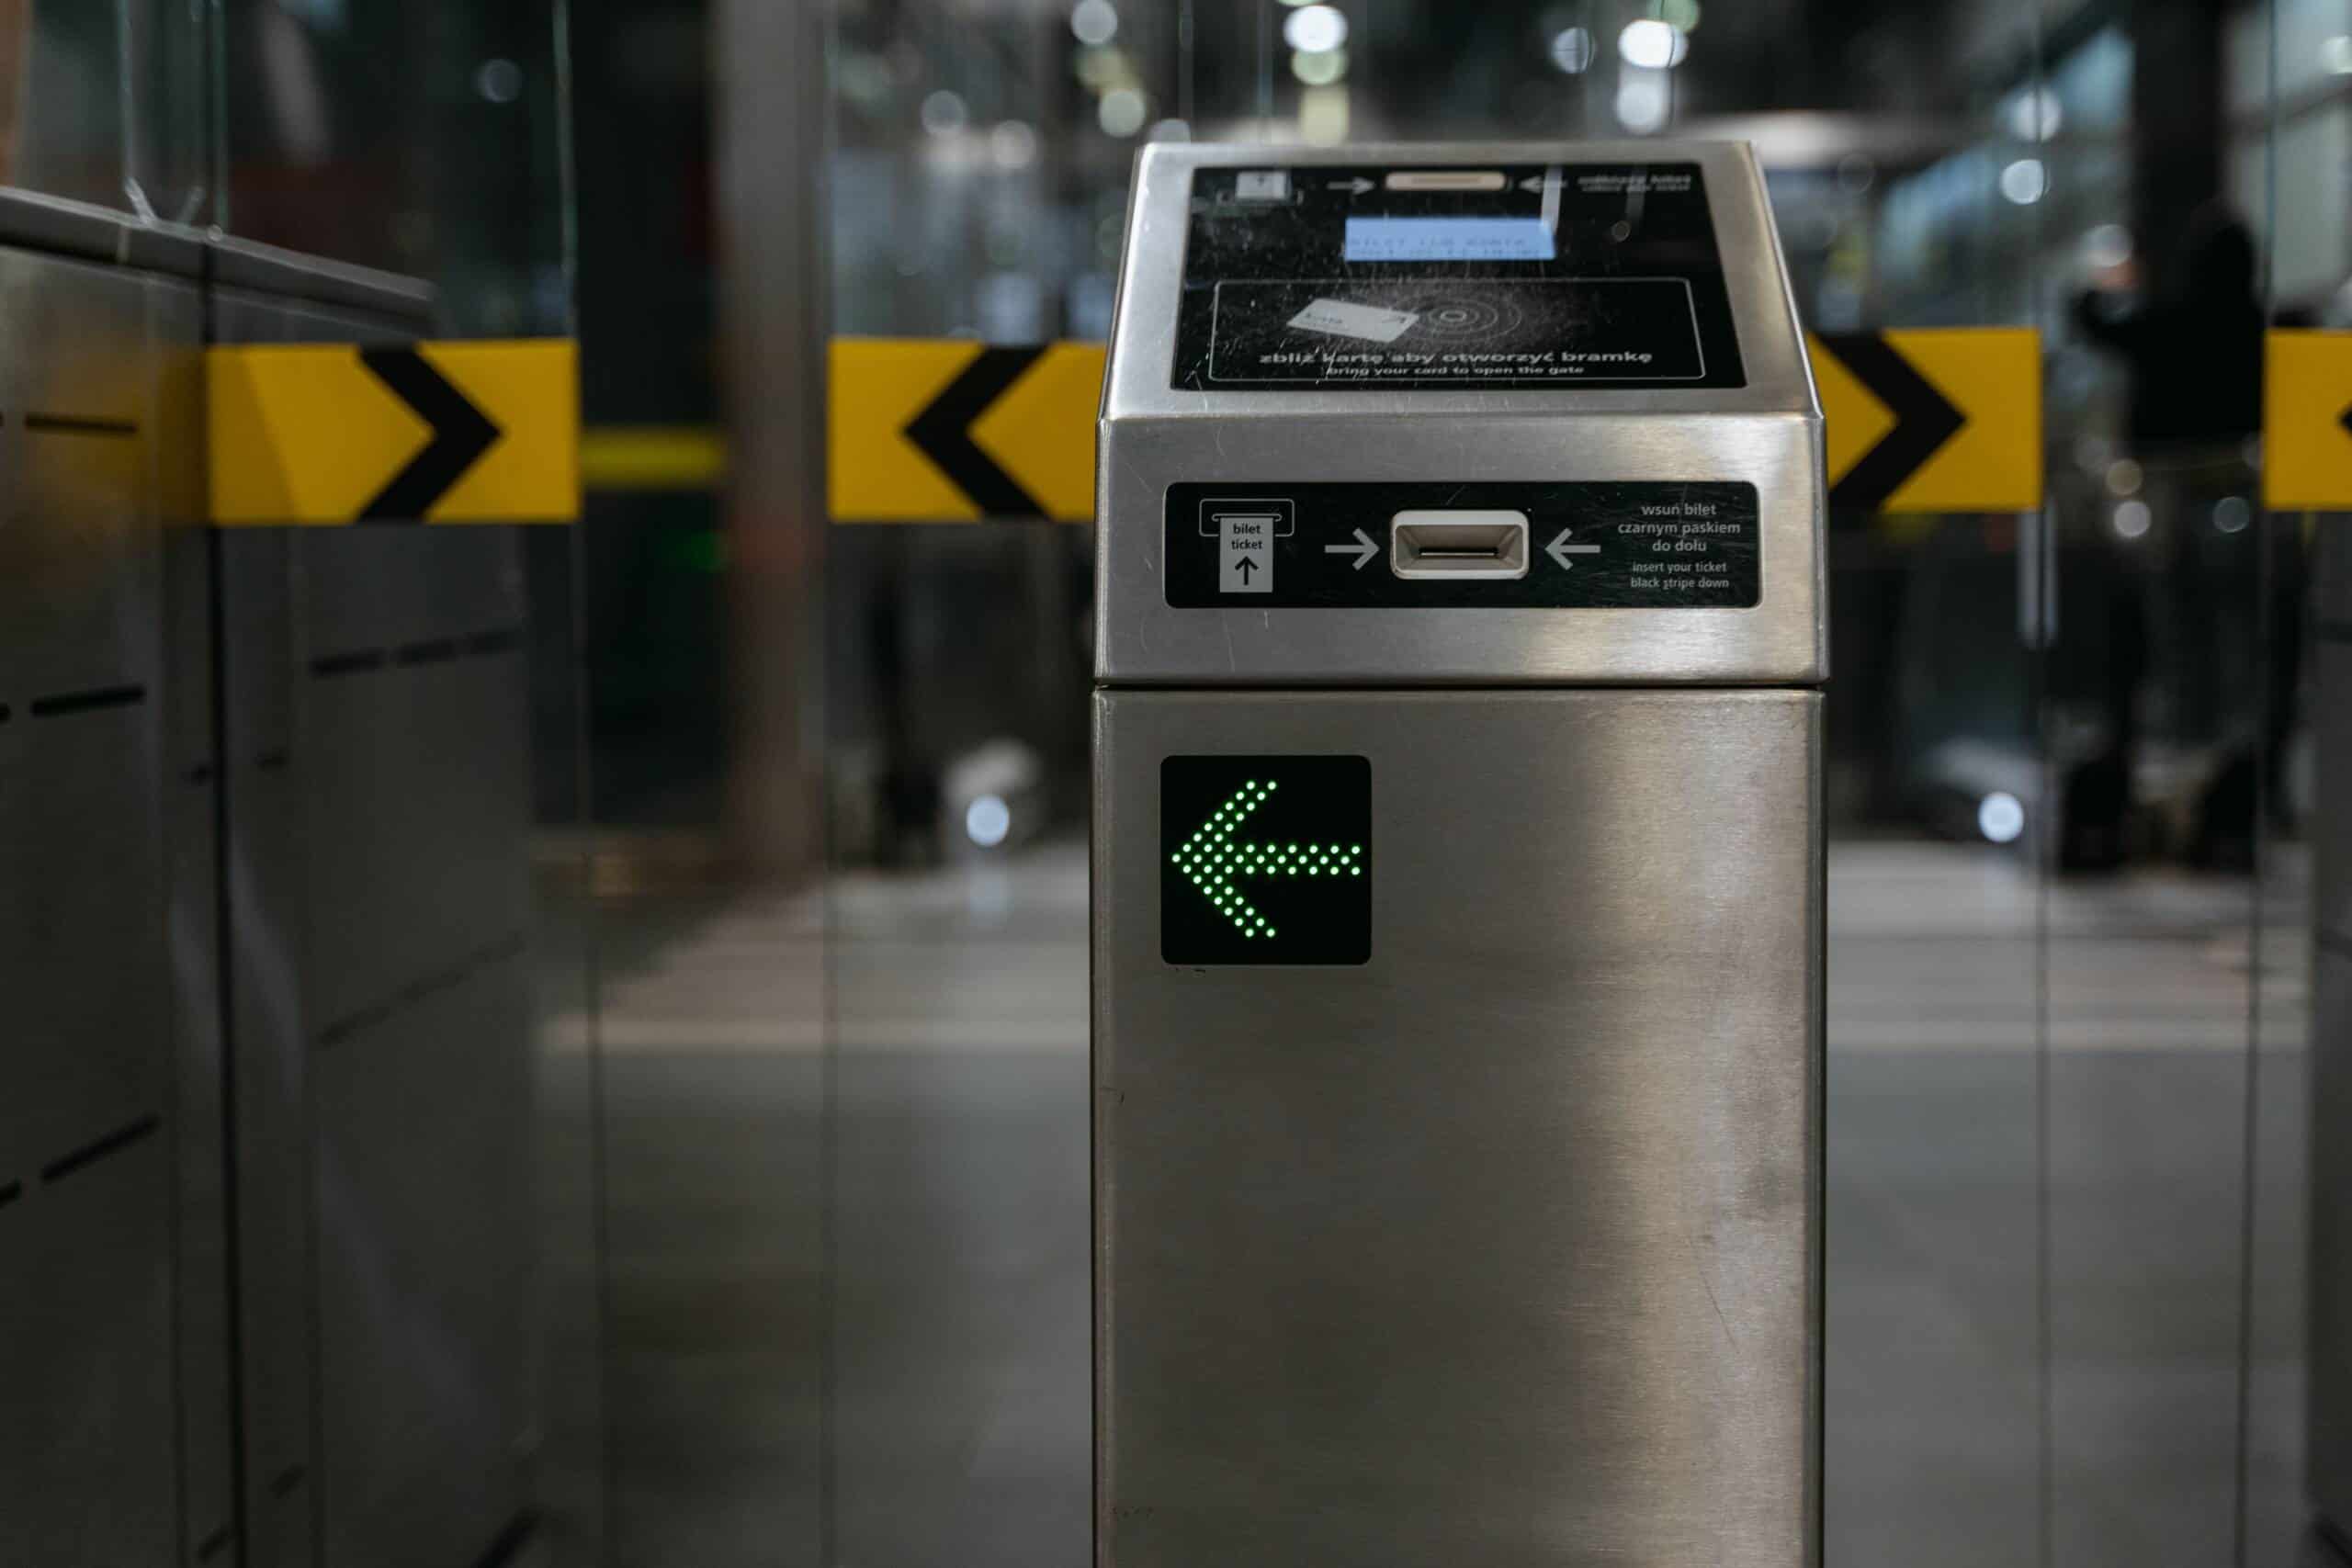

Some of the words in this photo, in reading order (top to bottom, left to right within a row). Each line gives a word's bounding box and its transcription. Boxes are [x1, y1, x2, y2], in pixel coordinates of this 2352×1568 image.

[1322, 352, 1384, 364] kartę
[1391, 352, 1436, 364] aby
[1442, 352, 1555, 364] otworzyć
[1561, 351, 1653, 364] bramkę
[1328, 367, 1370, 377] bring
[1374, 367, 1408, 376] your
[1414, 367, 1448, 375] card
[1453, 367, 1470, 375] to
[1474, 367, 1514, 376] open
[1518, 367, 1545, 375] the
[1548, 367, 1586, 376] gate
[1684, 502, 1716, 515] bilet
[1233, 523, 1261, 534] bilet
[1618, 524, 1679, 536] czarnym
[1681, 522, 1741, 536] paskiem
[1231, 539, 1262, 550] ticket
[1652, 539, 1671, 551] do
[1633, 561, 1664, 572] insert
[1667, 563, 1692, 573] your
[1695, 561, 1727, 572] ticket
[1631, 577, 1660, 588] black
[1663, 578, 1695, 590] stripe
[1698, 577, 1729, 588] down
